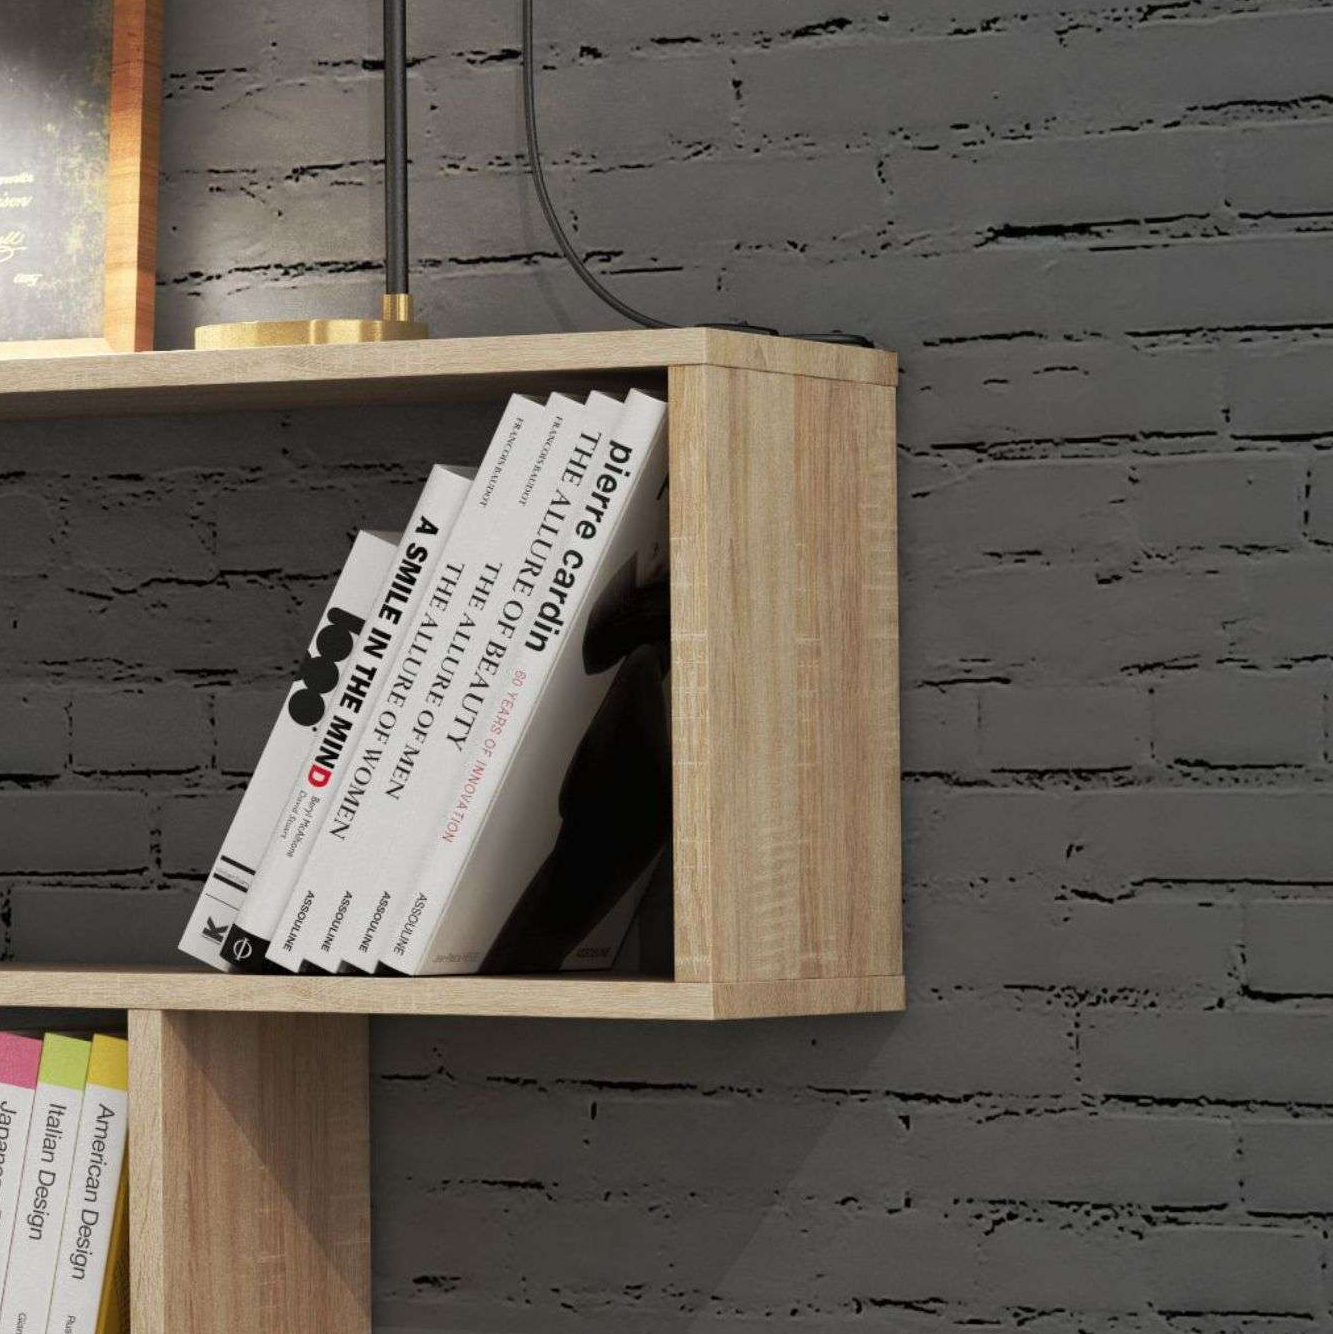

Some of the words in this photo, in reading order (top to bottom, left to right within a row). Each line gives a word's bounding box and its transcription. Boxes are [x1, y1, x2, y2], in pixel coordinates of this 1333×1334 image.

[519, 461, 541, 504] BAUDOT
[562, 433, 601, 482] THE
[576, 440, 632, 539] pierre
[415, 516, 438, 535] A
[515, 490, 571, 591] ALLURE
[379, 543, 428, 624] SMILE
[432, 564, 464, 606] THE
[471, 564, 500, 607] THE
[525, 550, 583, 651] cardin
[364, 628, 391, 659] IN
[498, 601, 523, 638] OF
[390, 613, 438, 702] ALLURE
[429, 621, 476, 700] ALLURE
[340, 665, 377, 713] THE
[447, 641, 507, 751] BEAUTY
[490, 692, 517, 735] YEARS
[308, 716, 353, 787] MIND
[374, 711, 396, 744] OF
[413, 710, 434, 739] OF
[482, 739, 496, 758] OF
[330, 750, 382, 840] WOMEN
[386, 745, 420, 799] MEN
[442, 760, 486, 842] INNOVATION
[283, 891, 314, 951] ASSOULINE
[321, 891, 352, 952] ASSOULINE
[359, 891, 390, 952] ASSOULINE
[394, 893, 427, 956] ASSOULINE
[41, 1104, 67, 1162] Italian
[85, 1104, 115, 1202] American
[27, 1170, 56, 1240] Design
[70, 1209, 99, 1280] Design
